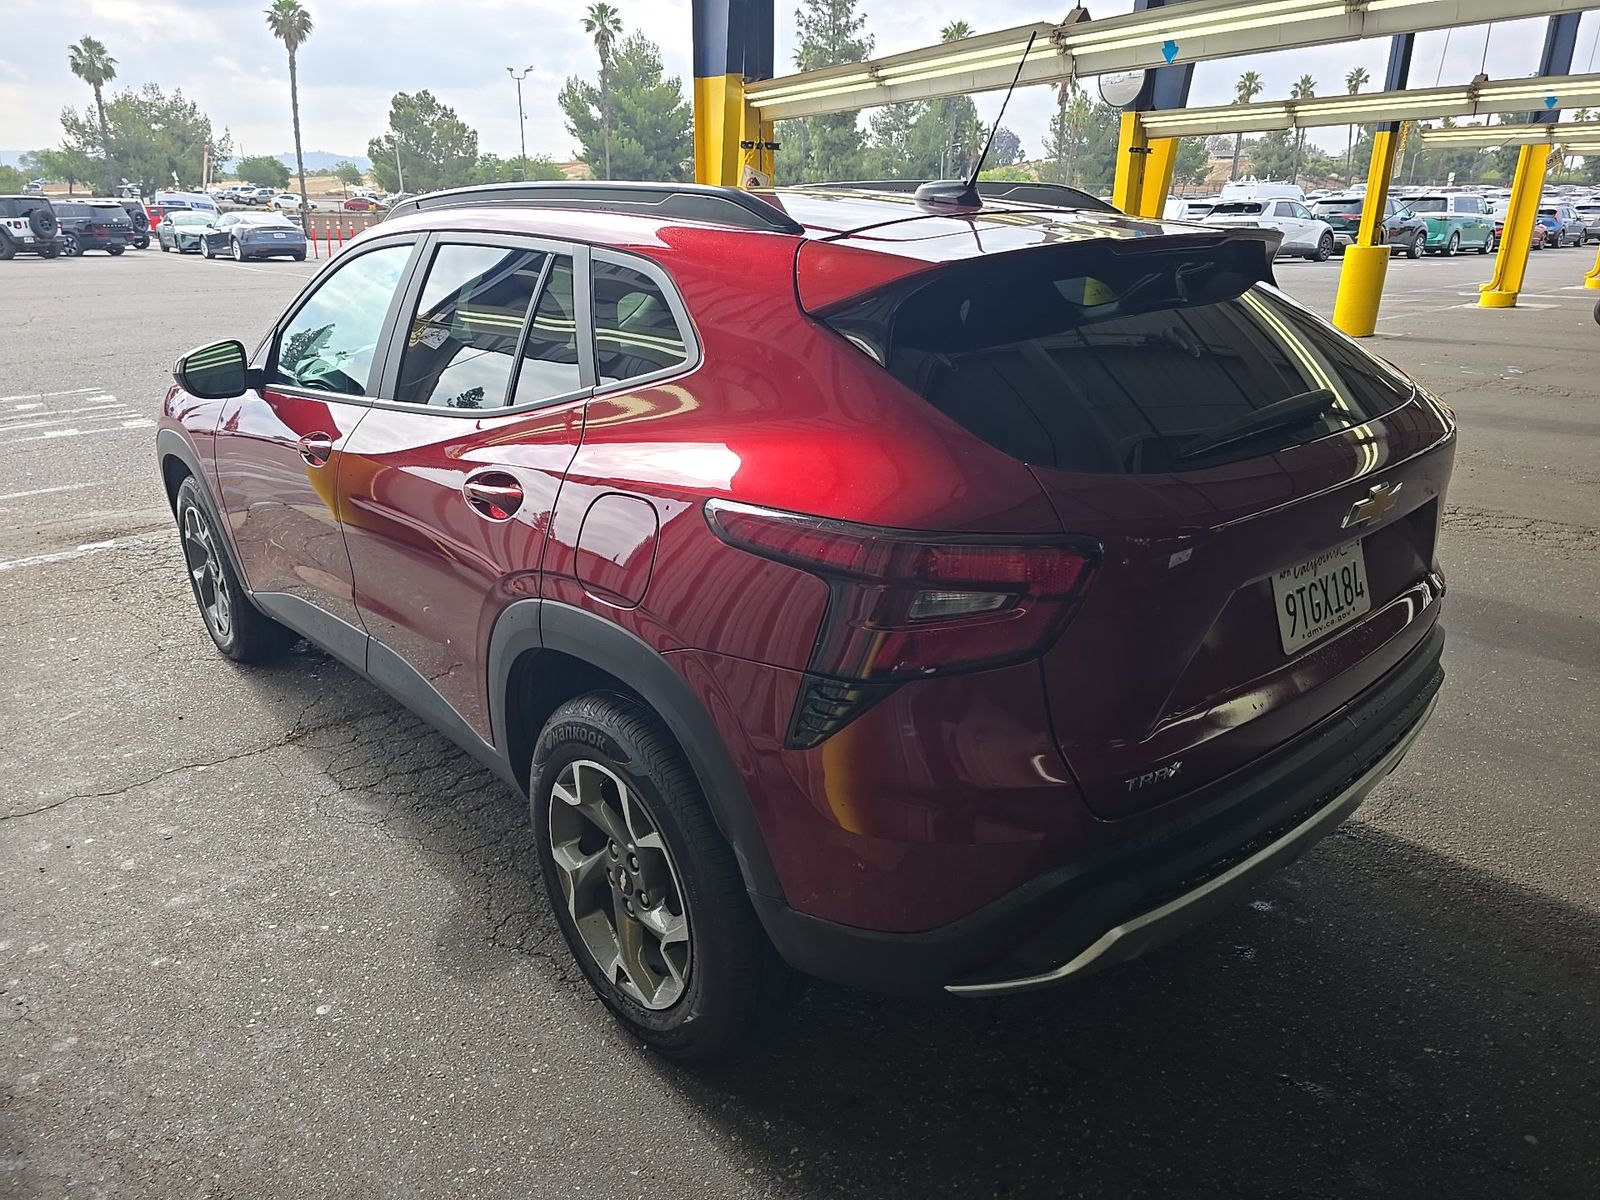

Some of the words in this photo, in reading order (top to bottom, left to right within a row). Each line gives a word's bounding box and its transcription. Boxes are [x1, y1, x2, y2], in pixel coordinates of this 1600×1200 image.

[1285, 561, 1364, 638] 9TGX184
[1306, 610, 1351, 639] dmv.ca.gov
[1125, 761, 1183, 792] TRAX
